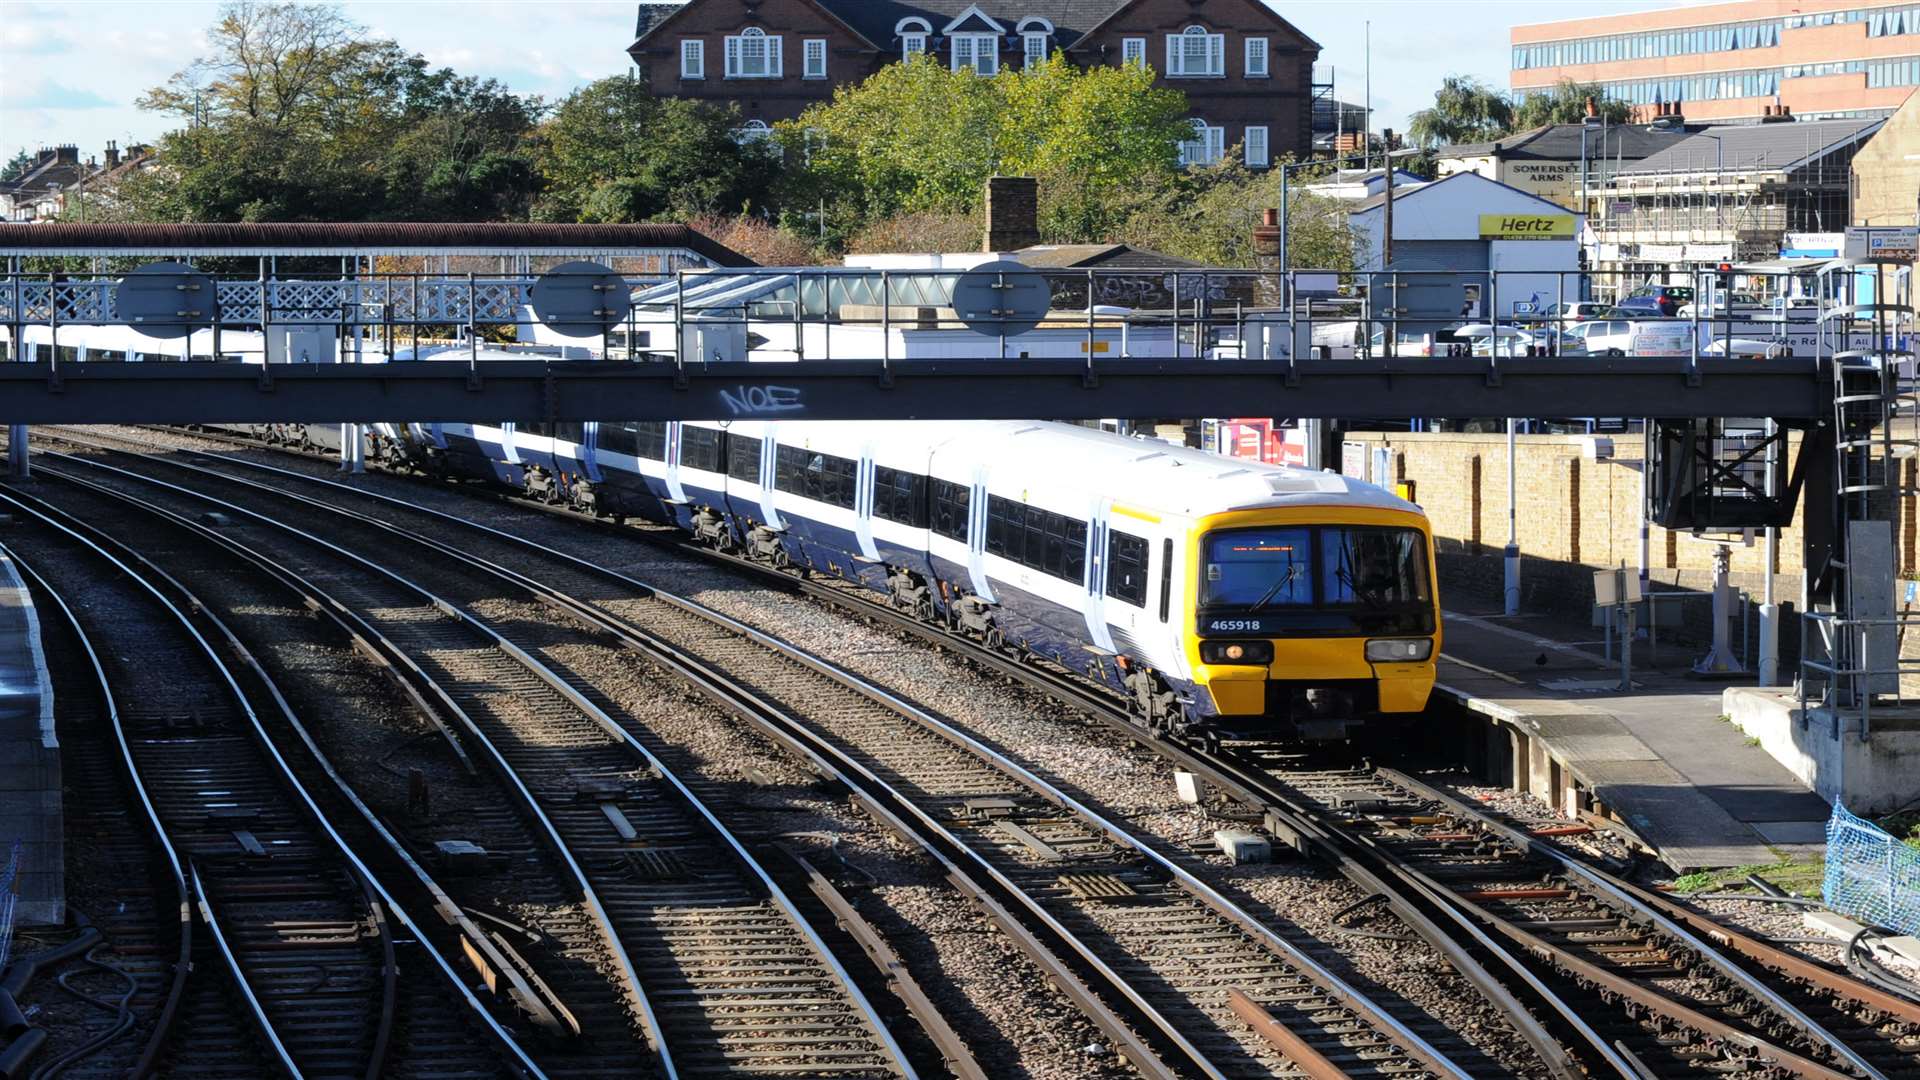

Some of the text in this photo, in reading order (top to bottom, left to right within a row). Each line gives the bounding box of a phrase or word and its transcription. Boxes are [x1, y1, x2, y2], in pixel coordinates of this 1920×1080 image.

[1513, 165, 1579, 173] SOMERSET
[1529, 174, 1564, 182] ARMS
[1501, 218, 1554, 231] Hertz
[1801, 337, 1817, 346] Rd
[1855, 338, 1869, 346] All
[1211, 620, 1260, 631] 465918
